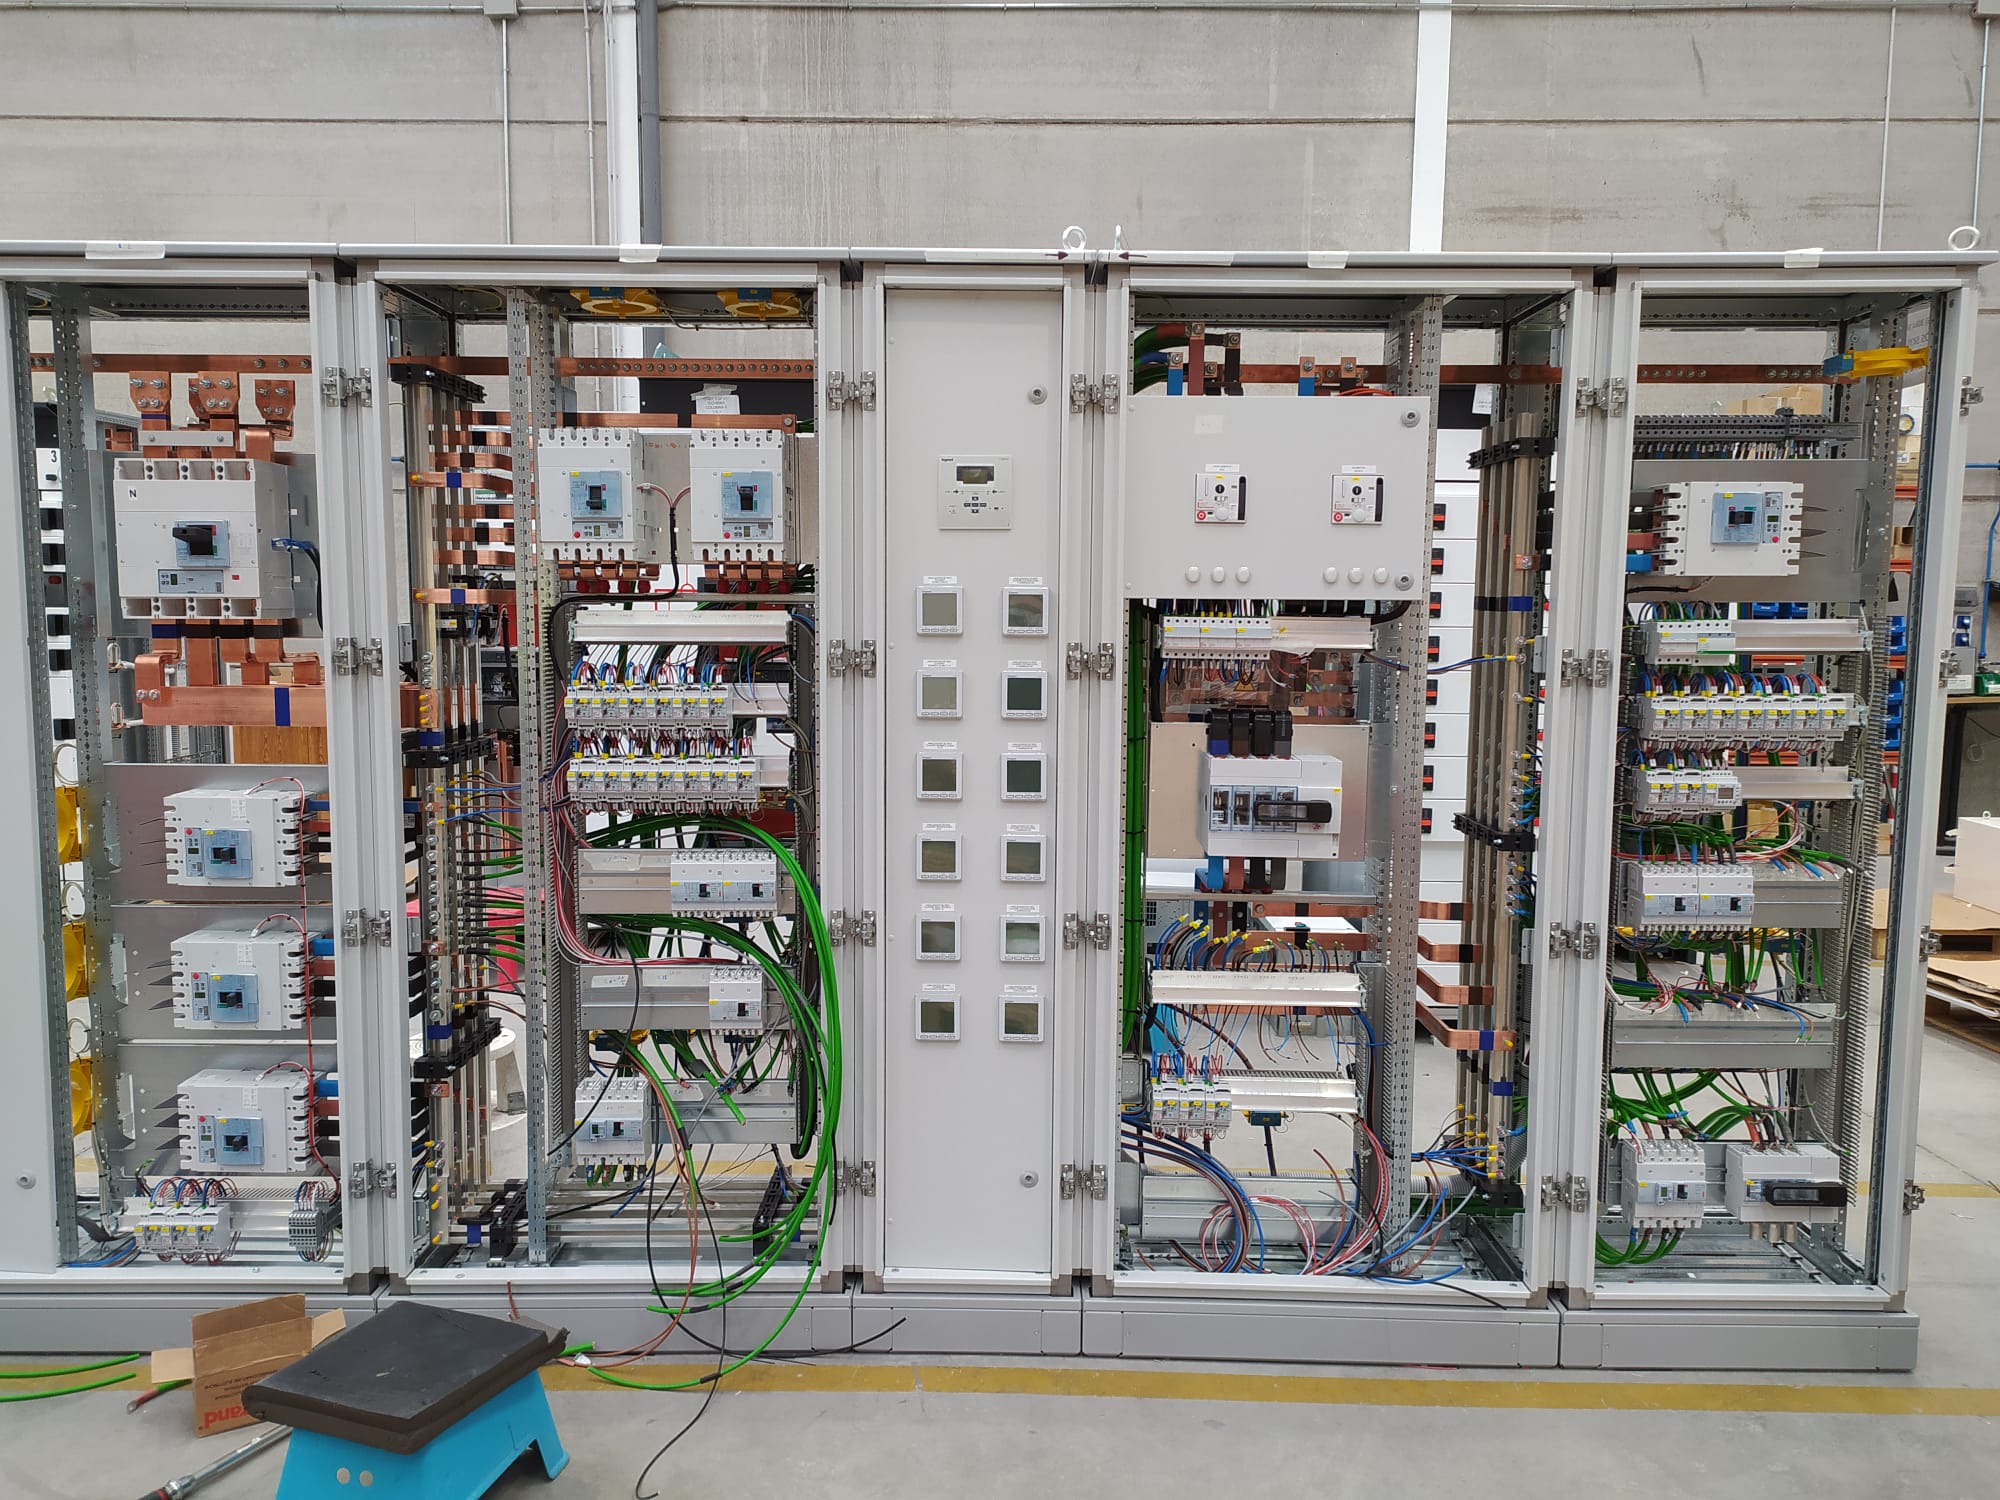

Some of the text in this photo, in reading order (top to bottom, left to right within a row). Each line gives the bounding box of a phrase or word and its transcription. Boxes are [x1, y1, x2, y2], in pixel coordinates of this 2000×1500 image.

[50, 450, 57, 463] 3
[129, 489, 137, 498] N
[204, 1406, 248, 1429] rand
